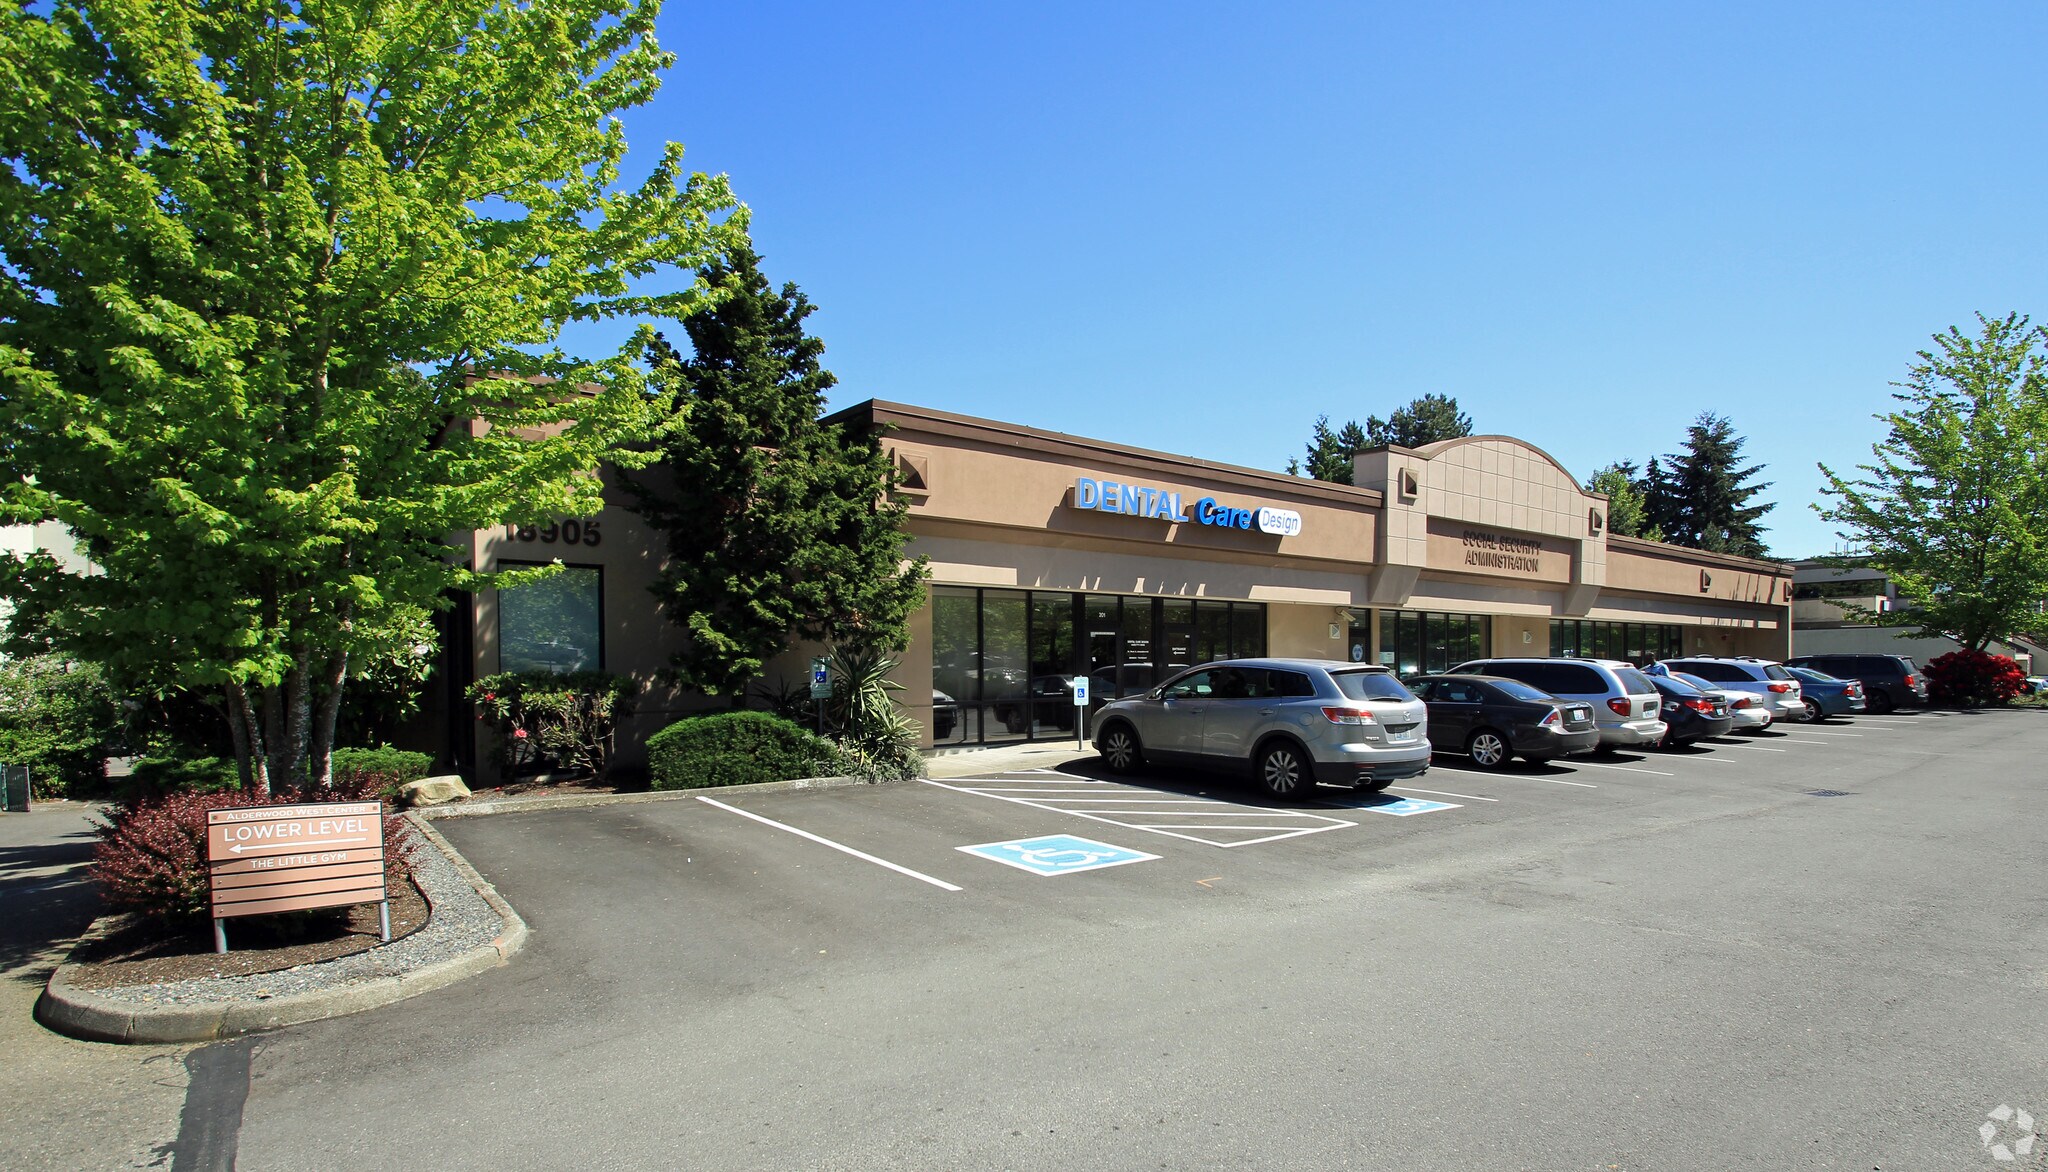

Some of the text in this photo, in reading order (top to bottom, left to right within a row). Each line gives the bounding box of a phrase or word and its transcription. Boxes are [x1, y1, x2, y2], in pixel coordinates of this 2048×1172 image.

[1077, 477, 1298, 534] DENTAL Care Design
[1462, 530, 1542, 556] SOCIAL SECURITY
[1464, 550, 1538, 572] ADMINISTRATION
[226, 805, 366, 820] ALDERWOOD WEST CENTER
[224, 819, 368, 841] LOWER LEVEL
[250, 852, 347, 869] THE LITTLE GYM
